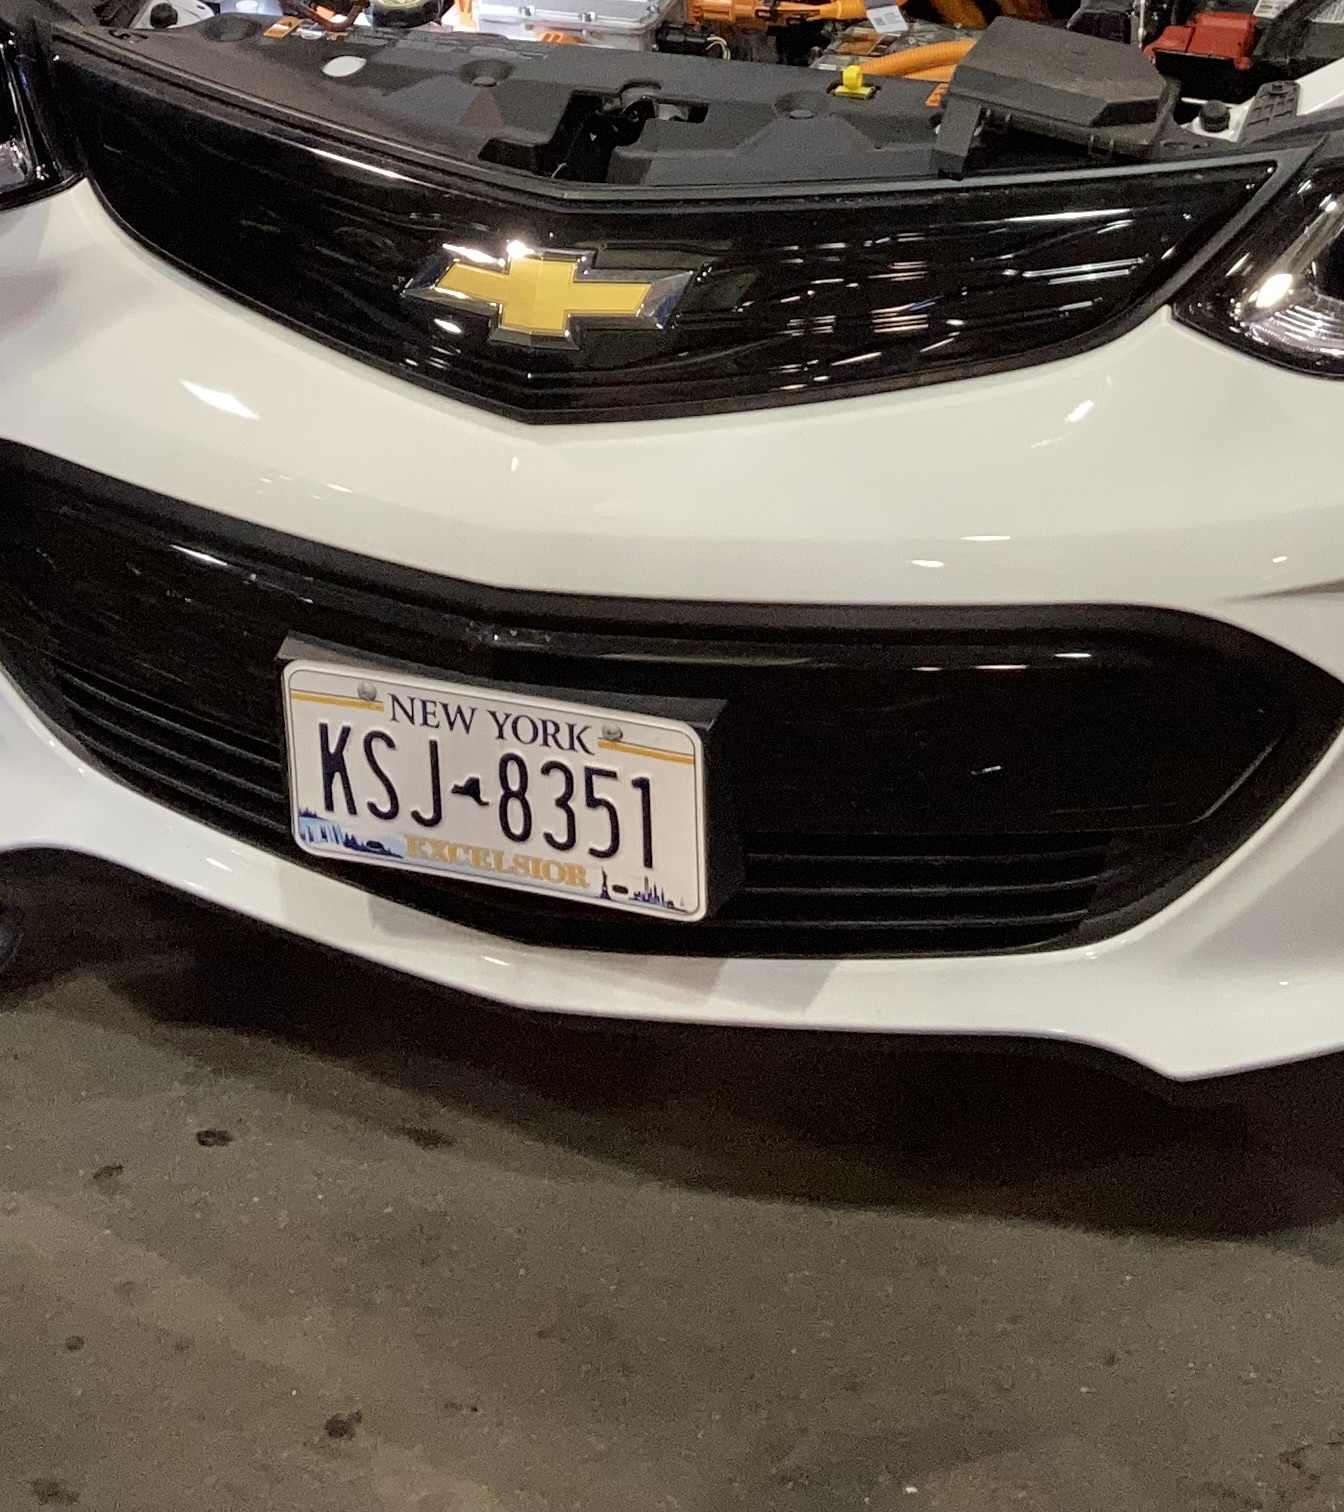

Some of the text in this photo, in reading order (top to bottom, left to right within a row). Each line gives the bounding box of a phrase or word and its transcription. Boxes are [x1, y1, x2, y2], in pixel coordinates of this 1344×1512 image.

[389, 693, 595, 756] NEW YORK
[318, 722, 654, 869] KSJ 8351
[404, 834, 591, 889] EXCELSIOR
